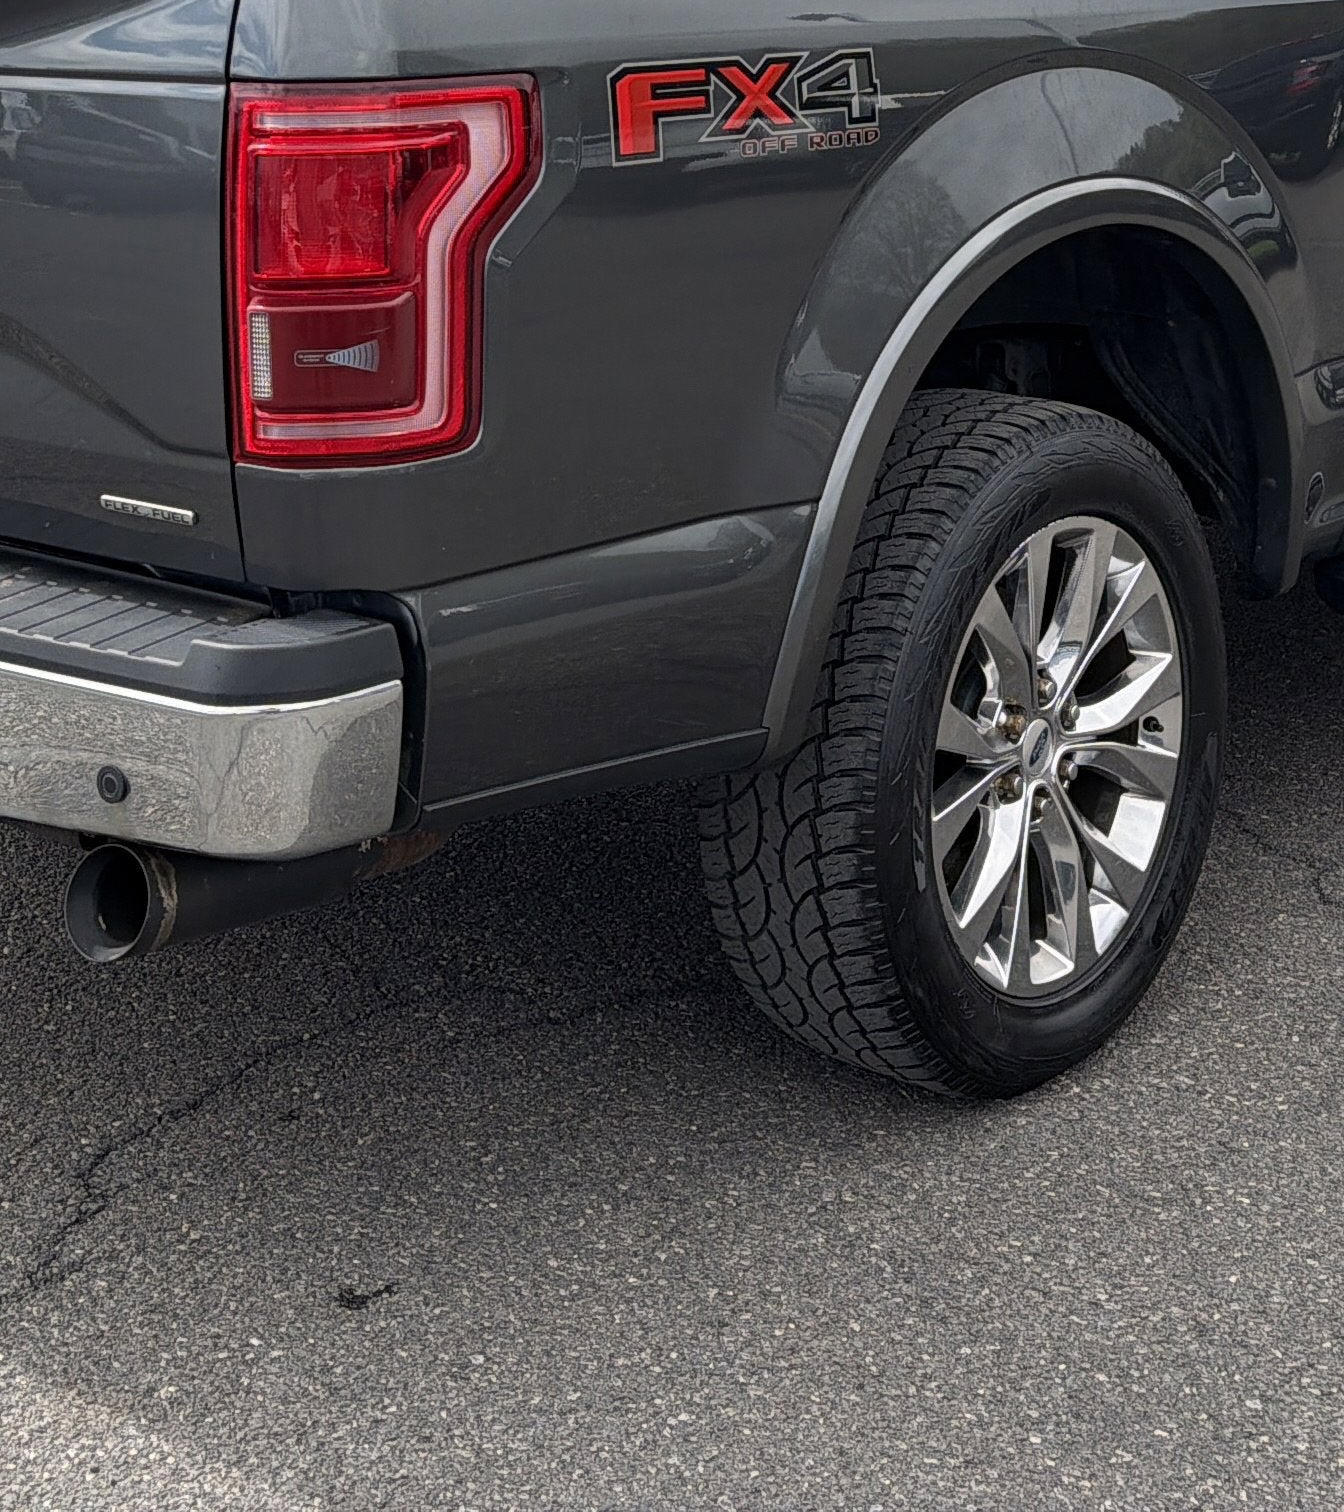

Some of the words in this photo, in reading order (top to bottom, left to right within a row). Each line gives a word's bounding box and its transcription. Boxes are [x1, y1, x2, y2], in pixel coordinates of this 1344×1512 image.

[607, 47, 881, 167] FX4
[740, 136, 798, 157] OFF
[808, 128, 880, 151] ROAD
[104, 499, 142, 515] FLEX
[152, 509, 190, 525] FUEL
